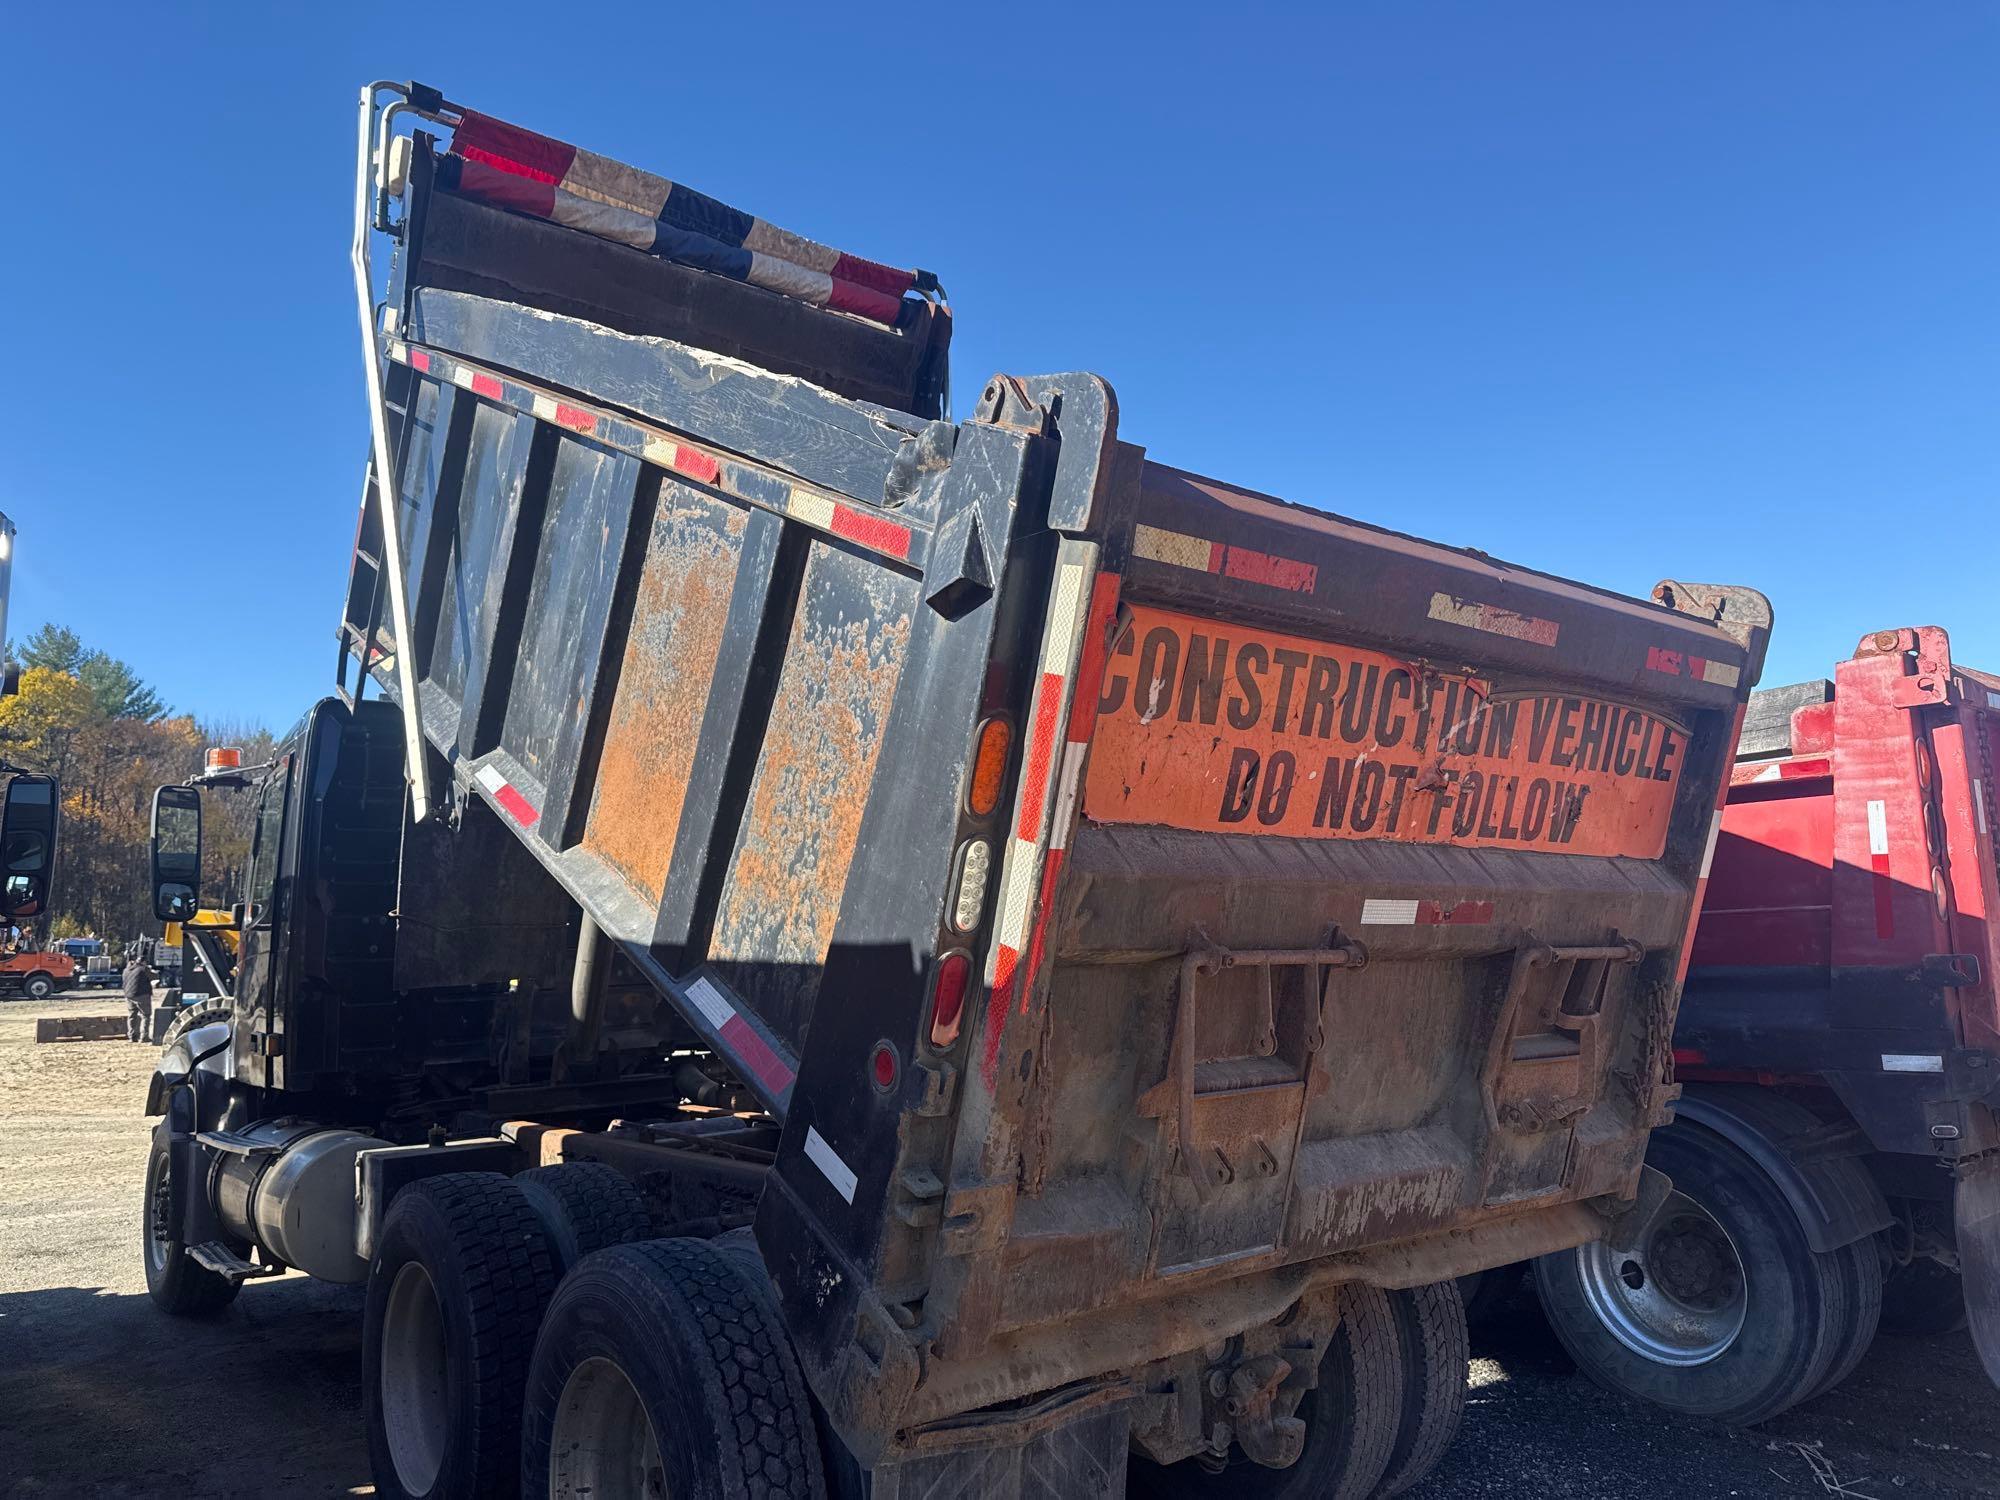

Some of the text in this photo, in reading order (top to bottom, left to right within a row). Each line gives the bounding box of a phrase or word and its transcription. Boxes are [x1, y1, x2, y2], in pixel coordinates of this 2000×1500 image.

[1097, 625, 1678, 781] CONSTRUCTION VEHICLE
[1218, 747, 1591, 844] DO NOT FOLLOW
